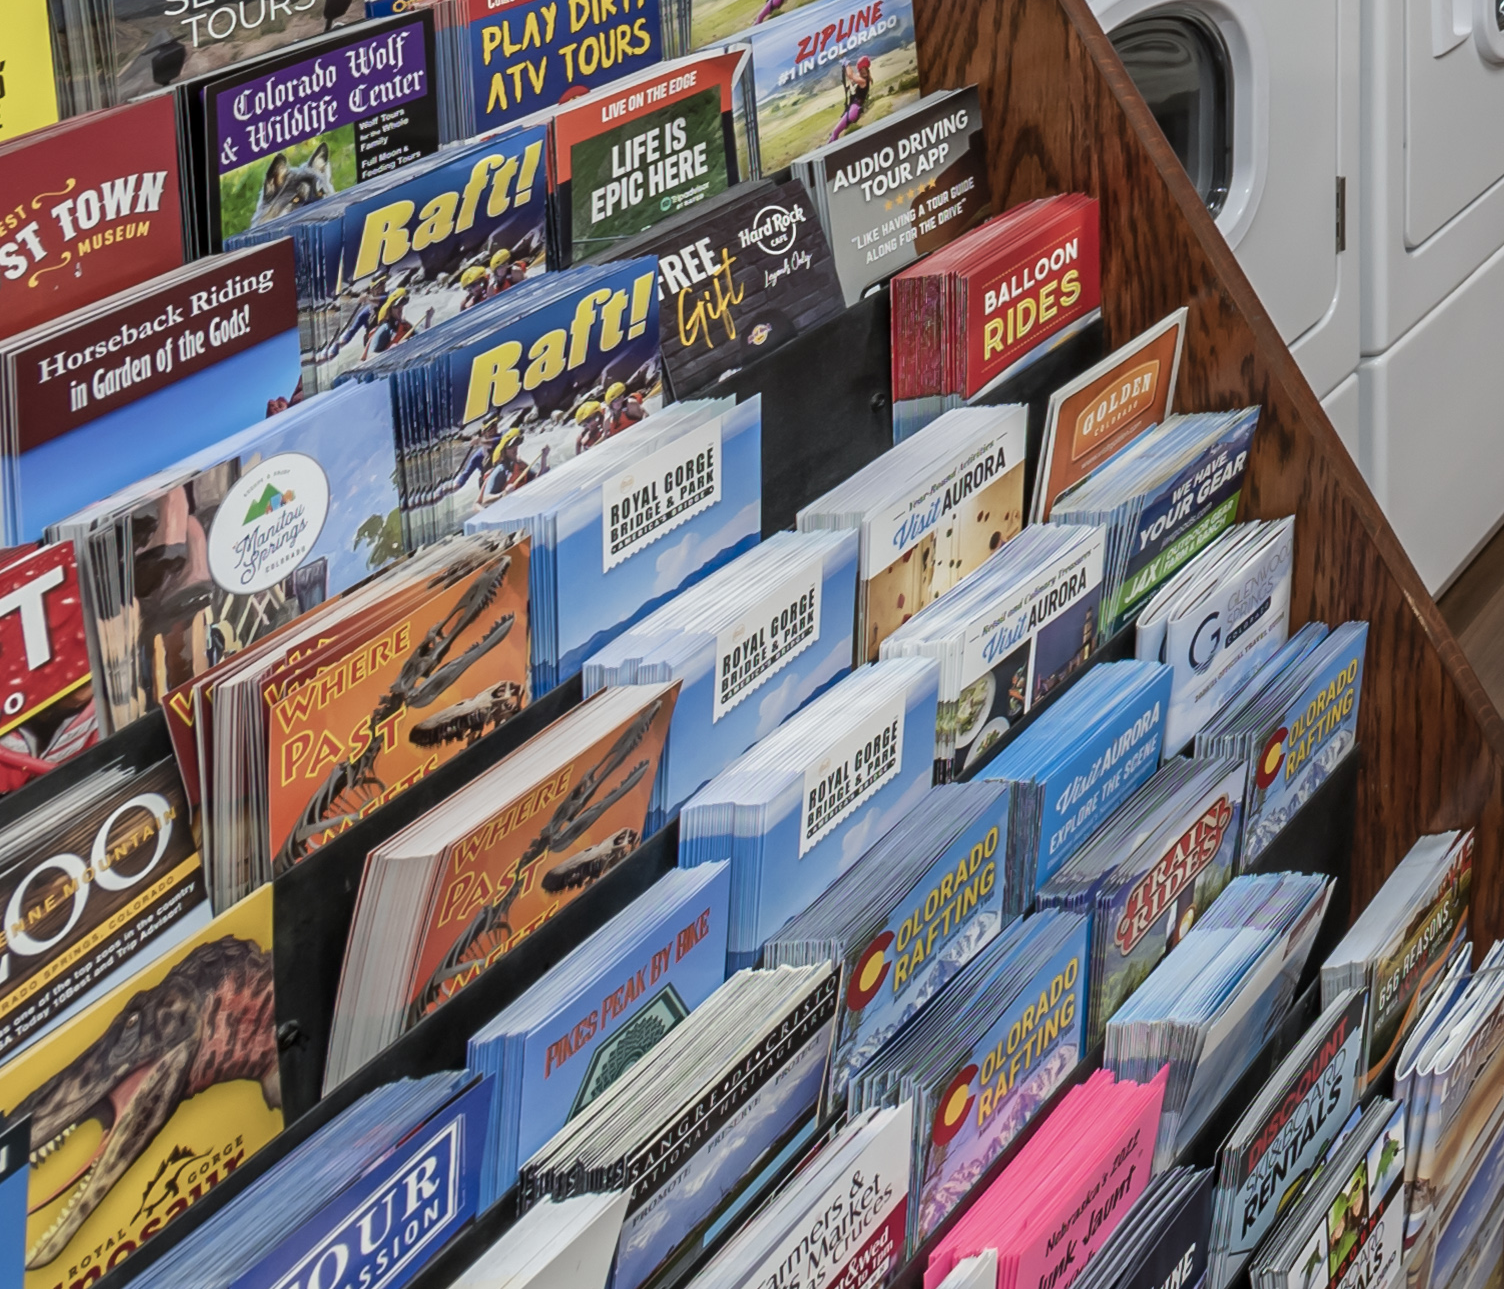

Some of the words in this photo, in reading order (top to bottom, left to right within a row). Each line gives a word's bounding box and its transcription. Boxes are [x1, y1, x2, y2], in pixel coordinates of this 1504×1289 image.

[233, 59, 337, 120] Colorado
[345, 32, 411, 78] Wolf
[481, 1, 557, 66] PLAY
[486, 55, 547, 114] ATV
[558, 18, 651, 83] TOURS
[795, 0, 884, 65] ZIPLINE
[220, 139, 239, 165] &
[247, 94, 338, 155] Wildlife
[349, 69, 424, 114] Center
[601, 98, 625, 122] LIVE
[628, 92, 644, 110] ON
[645, 83, 667, 106] THE
[669, 70, 697, 97] EDGE
[591, 168, 645, 224] EPIC
[649, 143, 709, 197] HERE
[612, 128, 660, 179] LIFE
[665, 117, 687, 154] IS
[832, 142, 894, 192] AUDIO
[899, 109, 969, 159] DRIVING
[861, 165, 913, 201] TOUR
[916, 143, 949, 178] APP
[51, 171, 168, 241] TOWN
[76, 220, 151, 257] MUSEUM
[353, 139, 543, 281] Raft!
[739, 217, 772, 248] Hard
[773, 204, 806, 233] Rock
[677, 247, 745, 349] Gift
[983, 269, 1082, 361] RIDES
[984, 238, 1079, 315] BALLOON
[37, 305, 184, 384] Horseback
[189, 268, 275, 319] Riding
[70, 380, 88, 413] in
[92, 355, 152, 401] Garden
[155, 340, 175, 371] of
[178, 327, 205, 364] the
[209, 303, 251, 348] Gods!
[462, 271, 655, 424] Raft!
[1082, 371, 1152, 436] GOLDEN
[610, 477, 659, 528] ROYAL
[663, 446, 714, 494] GORGE
[610, 504, 663, 544] BRIDGE
[666, 494, 676, 509] &
[679, 468, 714, 502] PARK
[893, 496, 941, 551] Visit
[941, 446, 1007, 517] AURORA
[1140, 493, 1194, 551] YOUR
[1197, 450, 1248, 503] GEAR
[1172, 479, 1194, 505] WE
[1194, 450, 1229, 485] HAVE
[234, 504, 305, 569] Manitou
[241, 518, 308, 584] Springs
[1227, 536, 1293, 612] GLENWOOD
[982, 611, 1027, 664] Visit
[1026, 567, 1088, 633] AURORA
[276, 621, 411, 734] WHERE
[281, 707, 407, 787] PAST
[1285, 689, 1354, 781] RAFTING
[1130, 802, 1222, 911] TRAIN
[1130, 830, 1218, 941] RIDES
[894, 862, 995, 992] RAFTING
[1378, 968, 1399, 1011] 656
[1402, 900, 1450, 980] REASONS
[544, 1006, 599, 1080] PIKES
[601, 968, 645, 1031] PEAK
[649, 941, 673, 988] BY
[675, 908, 711, 965] BIKE
[630, 1095, 717, 1184] SANGRE
[732, 1059, 753, 1088] DE
[766, 973, 837, 1050] CRISTO
[978, 993, 1076, 1126] RAFTING
[1249, 1016, 1348, 1172] DISCOUNT
[187, 1134, 244, 1185] GORGE
[1241, 1075, 1342, 1241] RENTALS
[67, 1227, 126, 1280] ROYAL
[807, 1174, 880, 1279] Market
[833, 1183, 892, 1264] Cruces
